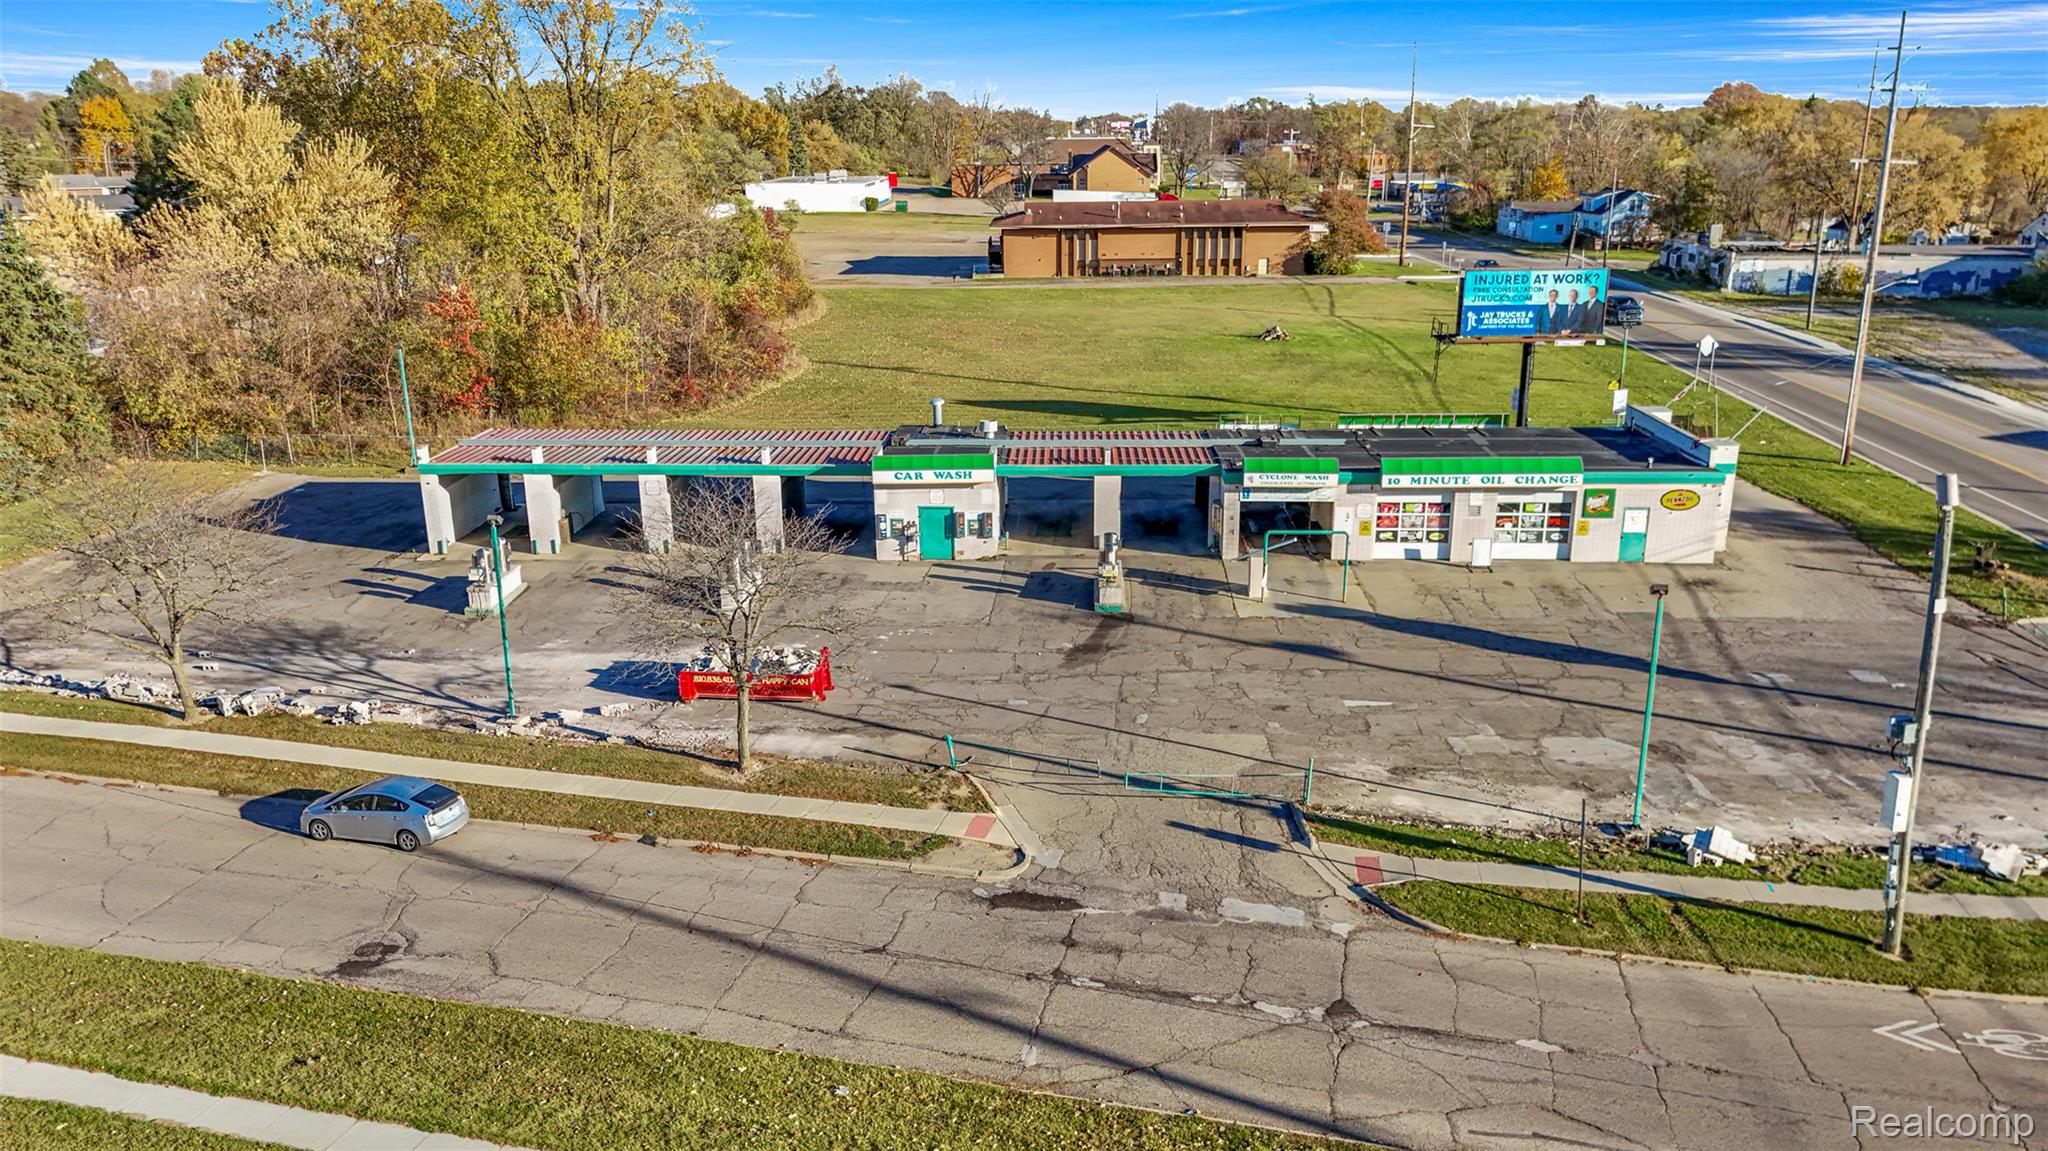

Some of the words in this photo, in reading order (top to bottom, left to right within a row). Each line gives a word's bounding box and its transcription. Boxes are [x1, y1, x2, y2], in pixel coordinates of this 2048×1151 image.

[1474, 274, 1529, 285] INJURED
[1533, 274, 1548, 284] AT
[1553, 273, 1600, 284] WORK?
[1471, 294, 1532, 302] JTRUCKS.COM
[894, 471, 923, 481] CAR
[933, 471, 973, 480] WASH
[1410, 476, 1471, 485] MINUTE
[1480, 475, 1505, 484] OIL
[1514, 475, 1579, 484] CHANGE
[762, 677, 788, 685] HAPPY
[791, 678, 809, 686] CAN
